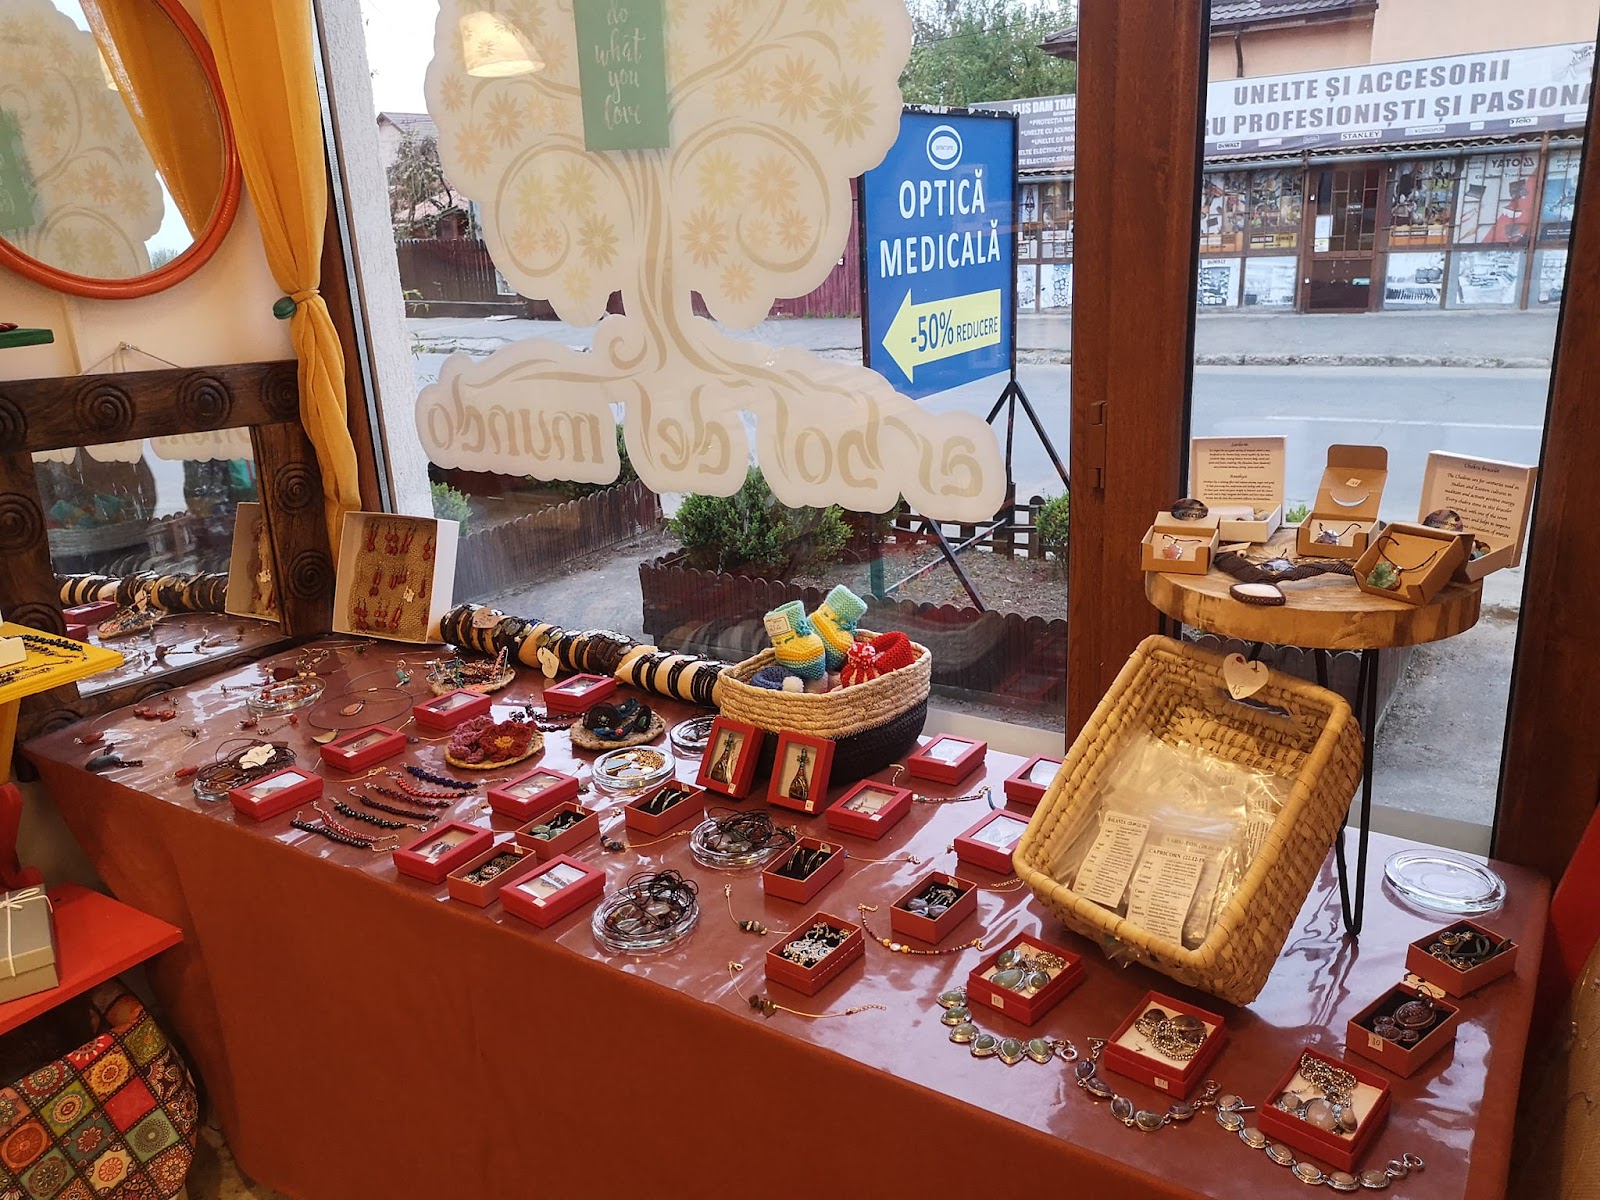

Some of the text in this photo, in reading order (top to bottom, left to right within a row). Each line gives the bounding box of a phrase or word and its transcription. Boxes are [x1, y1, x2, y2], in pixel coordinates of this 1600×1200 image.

[595, 27, 647, 66] what
[608, 68, 640, 104] you
[1234, 59, 1510, 106] UNELTE ȘI ACCESORII
[605, 94, 642, 130] love
[1033, 100, 1053, 113] DAM
[1233, 98, 1426, 134] PROFESIONIȘTI
[1434, 95, 1462, 123] ȘI
[1342, 131, 1380, 140] STANLEY
[1491, 158, 1521, 168] YATO
[899, 168, 986, 219] OPTICĂ
[879, 219, 1001, 278] MEDICALĂ
[911, 309, 999, 352] -50% REDUCERE
[1148, 848, 1181, 859] CAPRICORN
